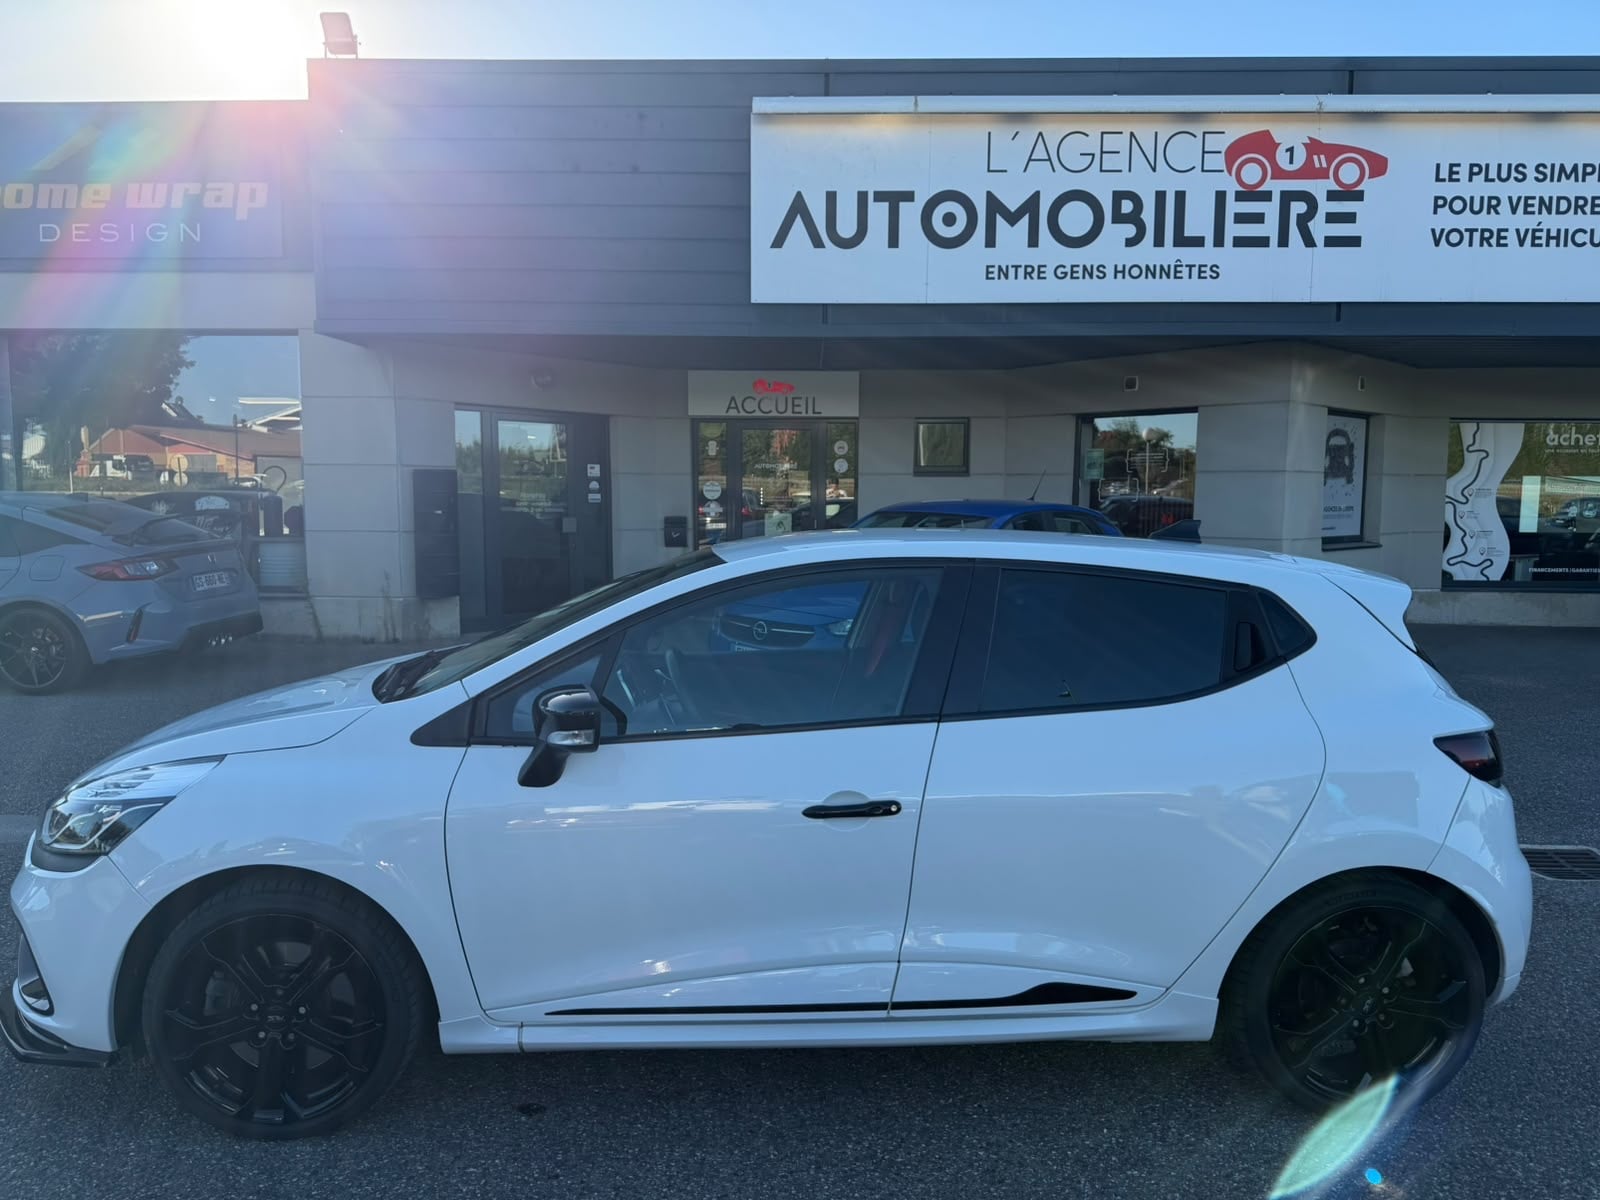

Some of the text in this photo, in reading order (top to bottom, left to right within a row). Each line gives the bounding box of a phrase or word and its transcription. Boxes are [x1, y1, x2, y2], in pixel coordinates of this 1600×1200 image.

[1434, 162, 1462, 183] LE
[1467, 162, 1528, 184] PLUS
[125, 181, 269, 221] wrap
[1432, 194, 1600, 216] POUR VENDRE
[769, 188, 1365, 250] AUTOMOBILIERE
[38, 222, 202, 243] DESIGN
[1430, 227, 1509, 248] VOTRE
[984, 258, 1221, 281] ENTRE GENS HONNÊTES
[725, 395, 823, 415] ACCUEIL
